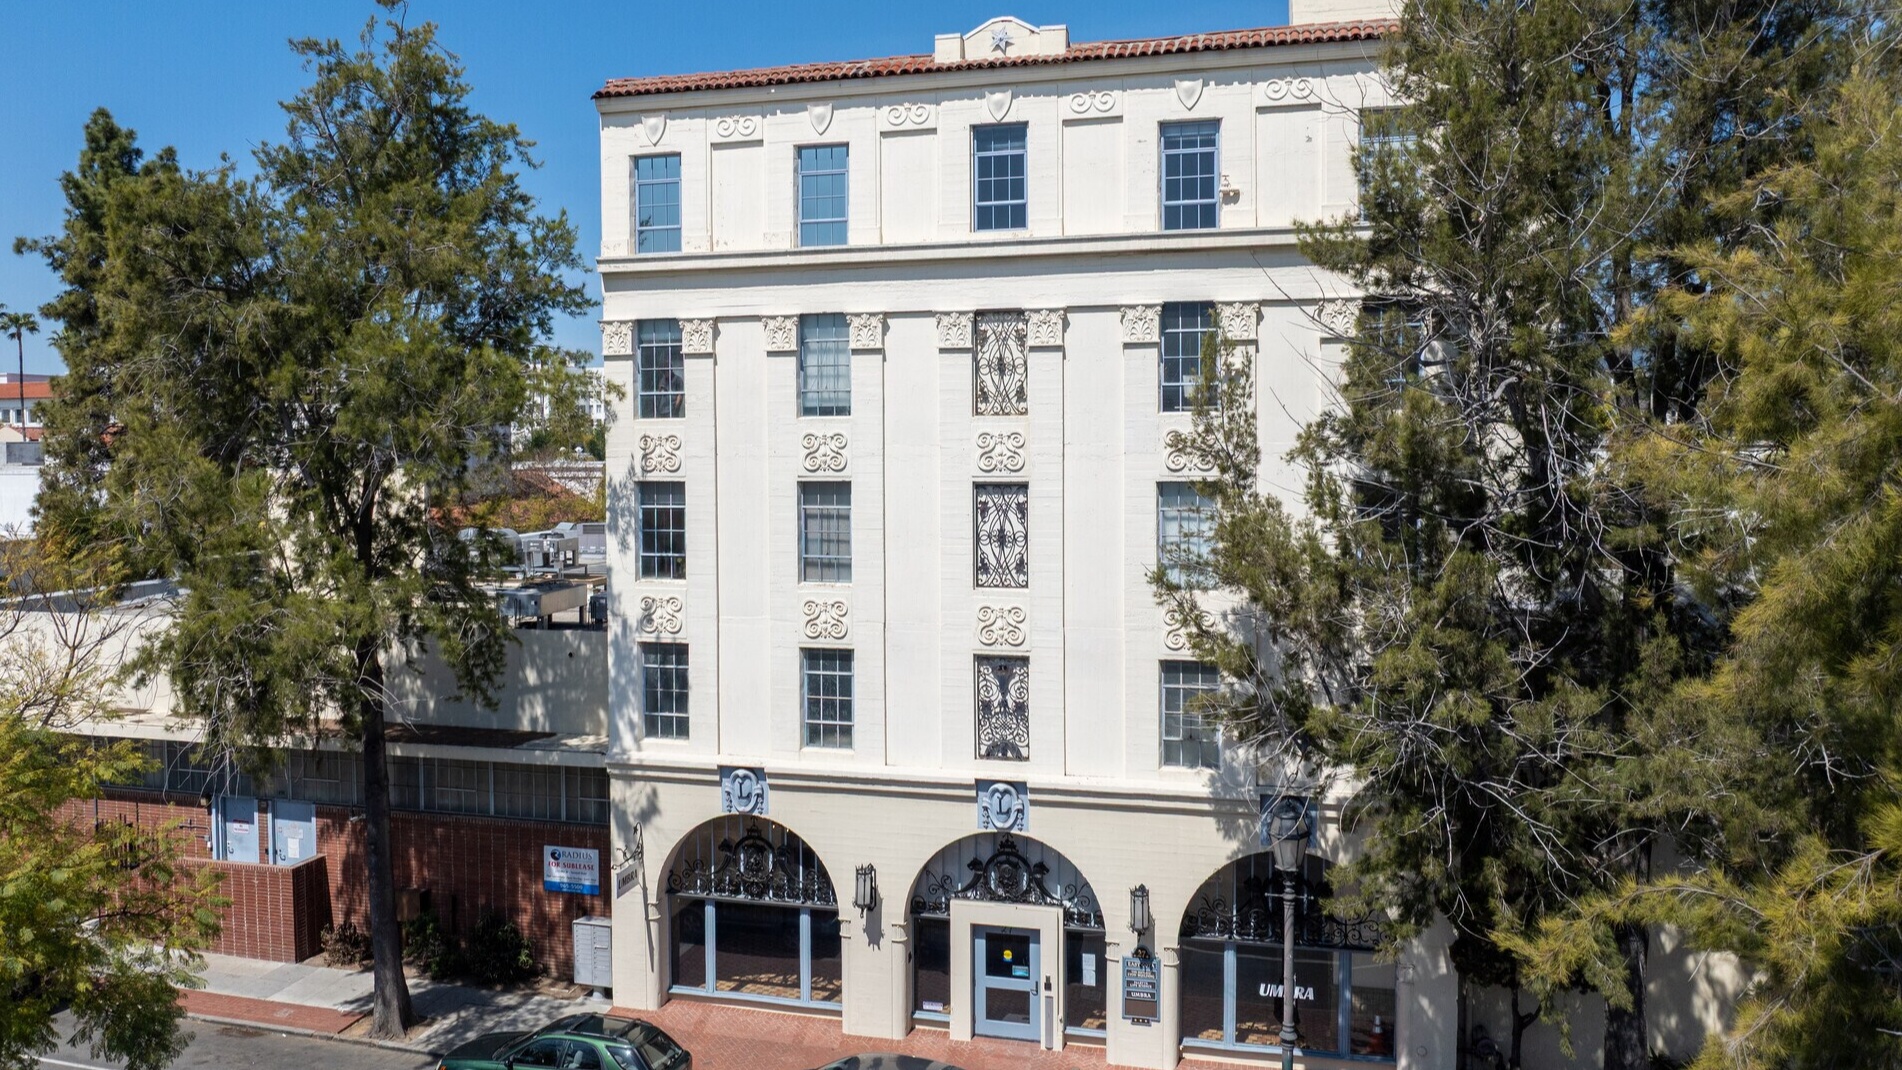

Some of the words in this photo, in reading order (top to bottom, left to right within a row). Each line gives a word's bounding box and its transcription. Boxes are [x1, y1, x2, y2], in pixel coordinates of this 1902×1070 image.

[562, 851, 593, 860] RADIUS
[562, 862, 595, 870] SUBLEASE
[618, 869, 638, 889] UMBRA
[1259, 983, 1314, 1000] UMRA
